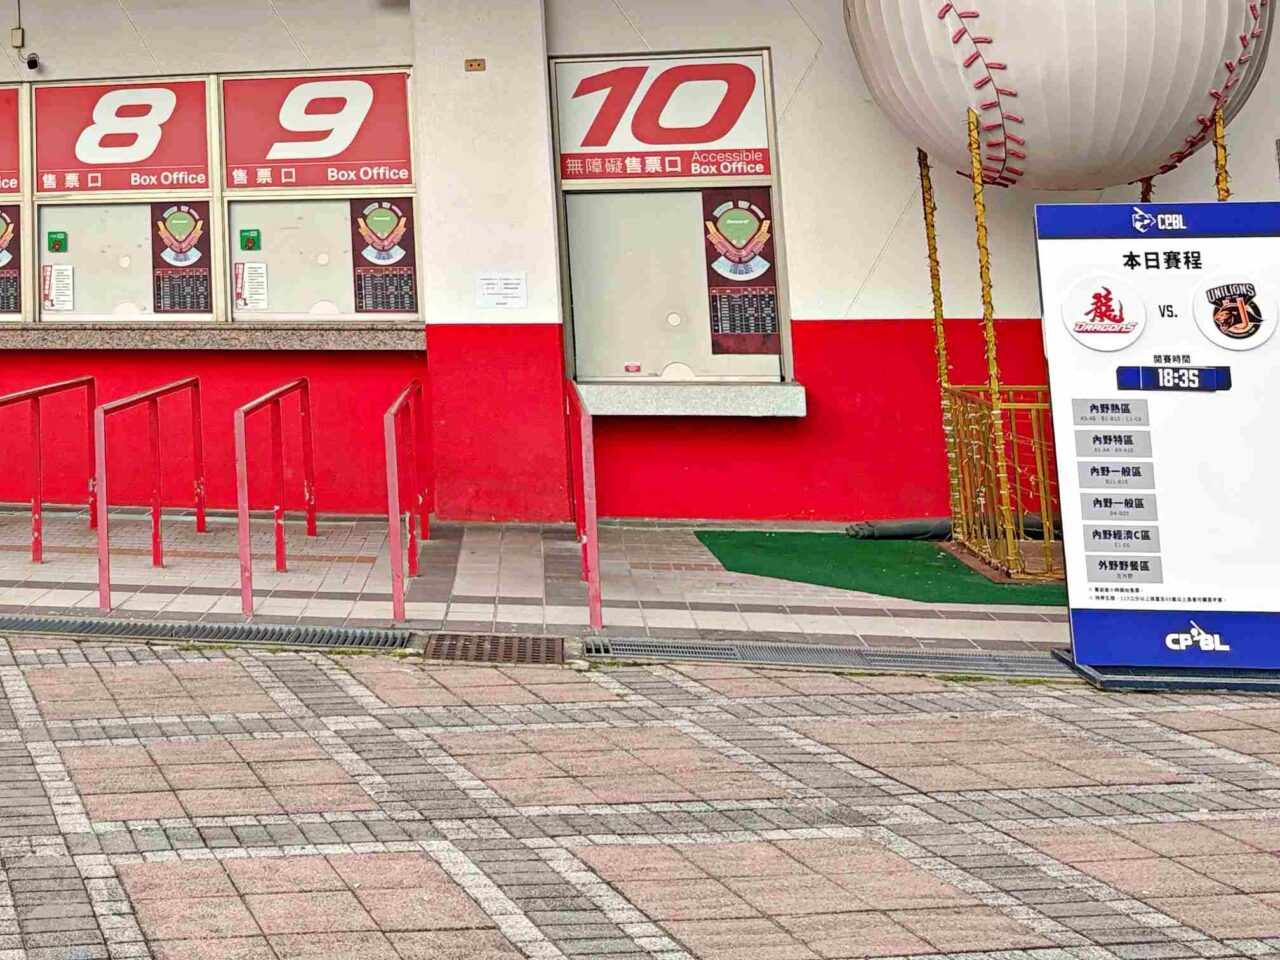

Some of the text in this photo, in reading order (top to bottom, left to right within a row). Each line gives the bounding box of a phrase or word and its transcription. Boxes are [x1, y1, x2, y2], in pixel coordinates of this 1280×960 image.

[571, 62, 757, 147] 10
[75, 87, 177, 164] 8
[265, 80, 374, 160] 9
[691, 150, 763, 162] Accessible
[231, 168, 296, 185] 售票口
[327, 166, 409, 182] Box Office
[691, 161, 765, 175] Box Office
[42, 172, 102, 189] 售票口
[130, 171, 206, 185] Box Office
[1157, 214, 1187, 230] CPBL
[1123, 251, 1203, 270] 本日賽程
[1207, 284, 1255, 303] UNILIONS
[1158, 304, 1178, 318] VS.
[1073, 322, 1138, 334] DRAGONS
[1158, 369, 1199, 388] 18:35
[1165, 627, 1230, 651] CPBL
